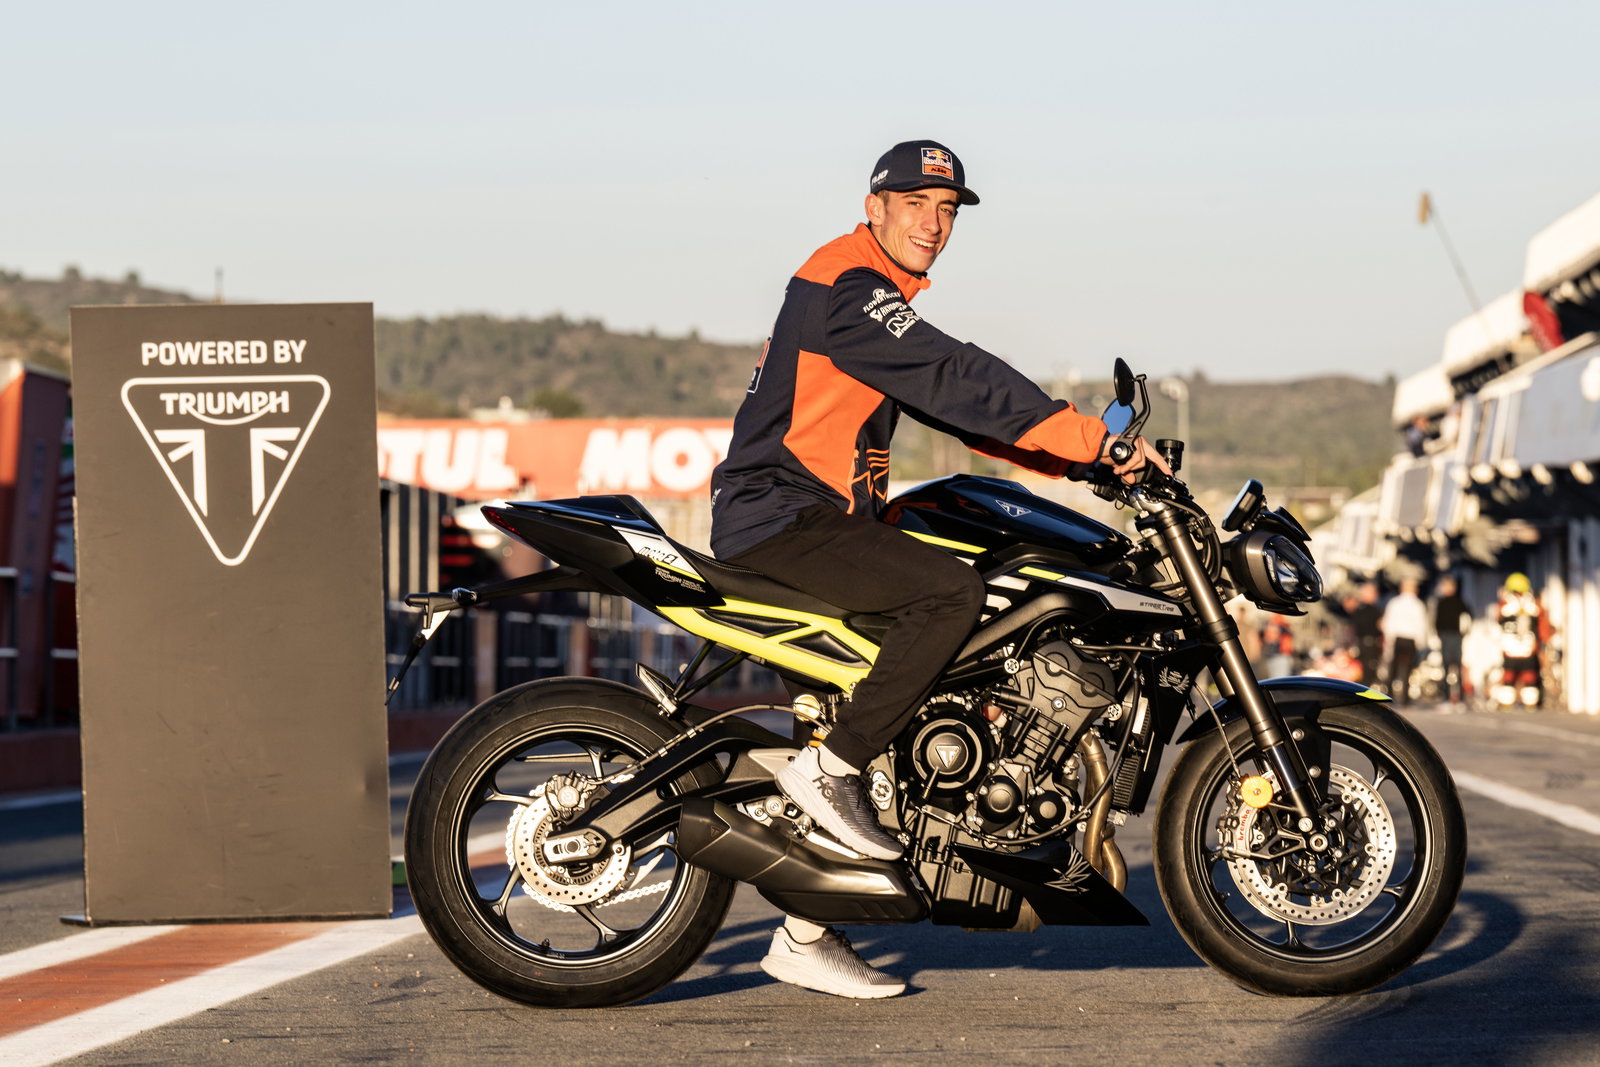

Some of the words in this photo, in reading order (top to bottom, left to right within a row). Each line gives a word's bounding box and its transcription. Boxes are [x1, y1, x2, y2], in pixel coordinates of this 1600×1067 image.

[141, 340, 267, 366] POWERED
[273, 339, 307, 364] BY
[159, 390, 290, 424] TRIUMPH
[377, 428, 519, 491] TUL
[1238, 809, 1251, 841] brembo
